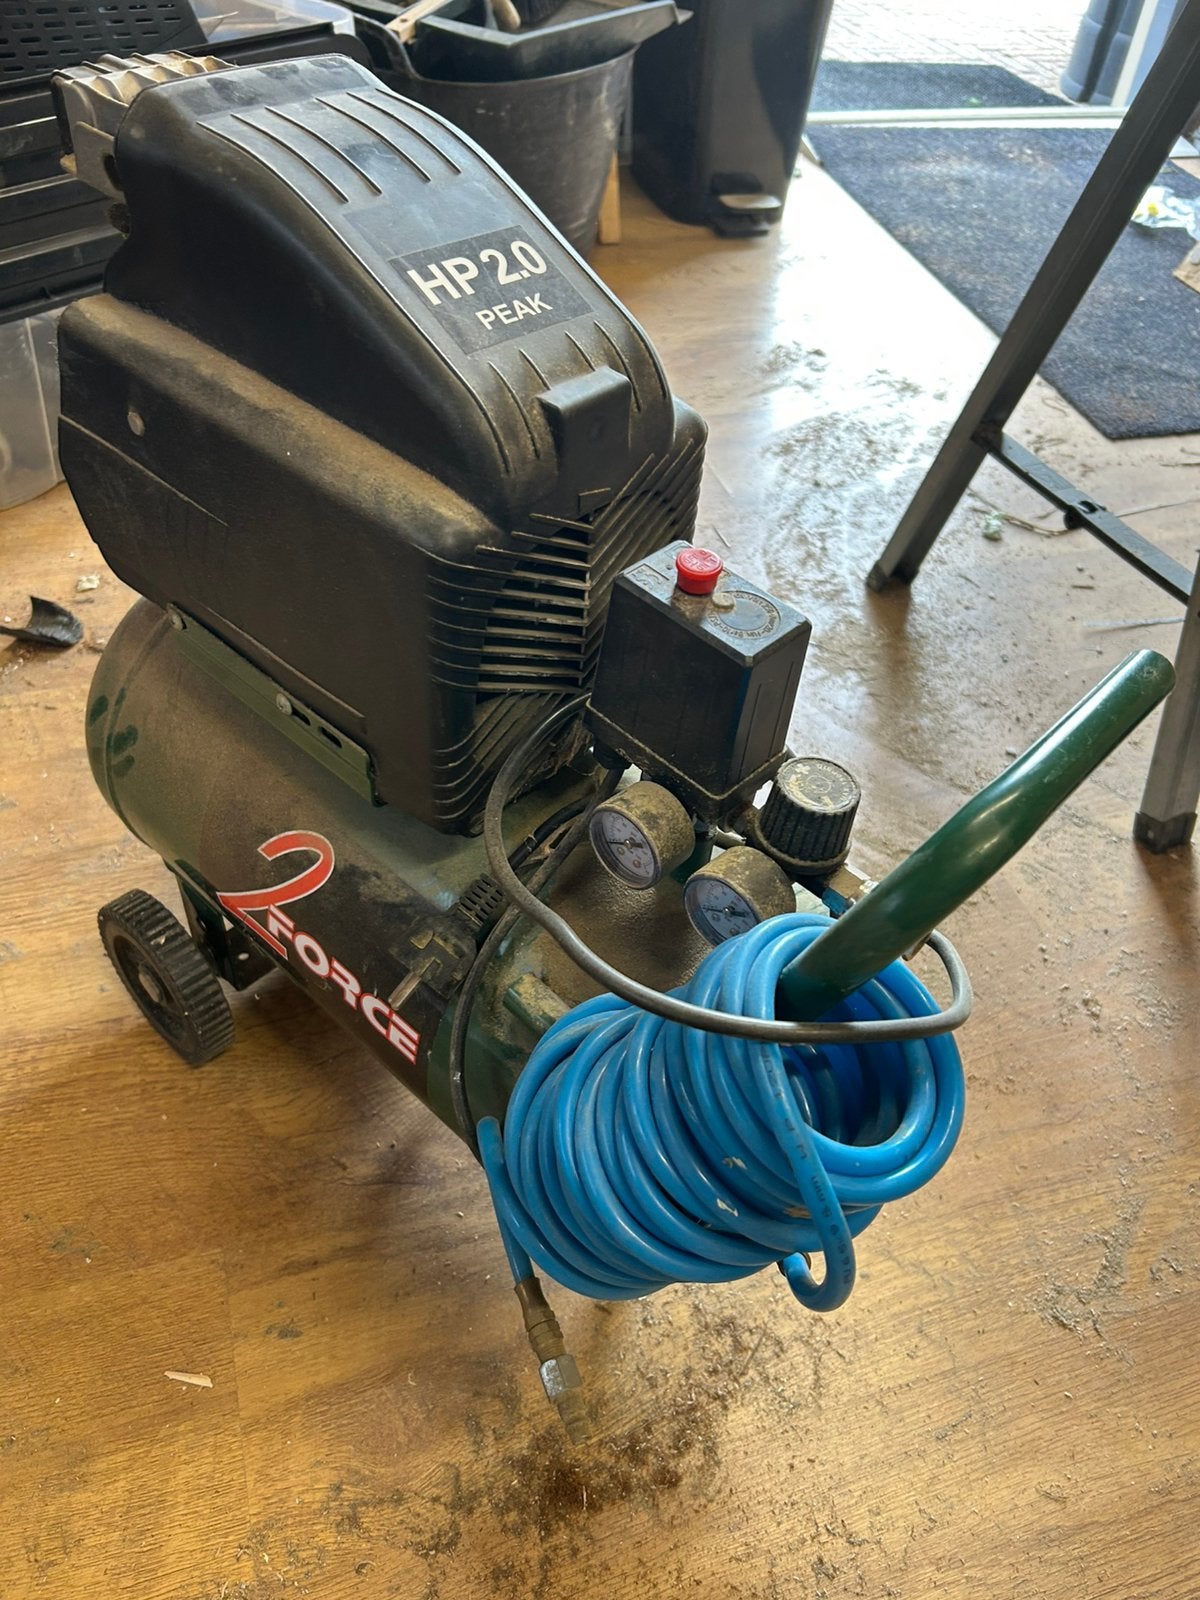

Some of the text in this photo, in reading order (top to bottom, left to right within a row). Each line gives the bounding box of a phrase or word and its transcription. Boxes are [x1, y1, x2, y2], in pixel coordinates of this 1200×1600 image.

[406, 240, 548, 306] HP 2.0
[475, 292, 553, 331] PEAK
[216, 829, 421, 1066] 2 FORCE
